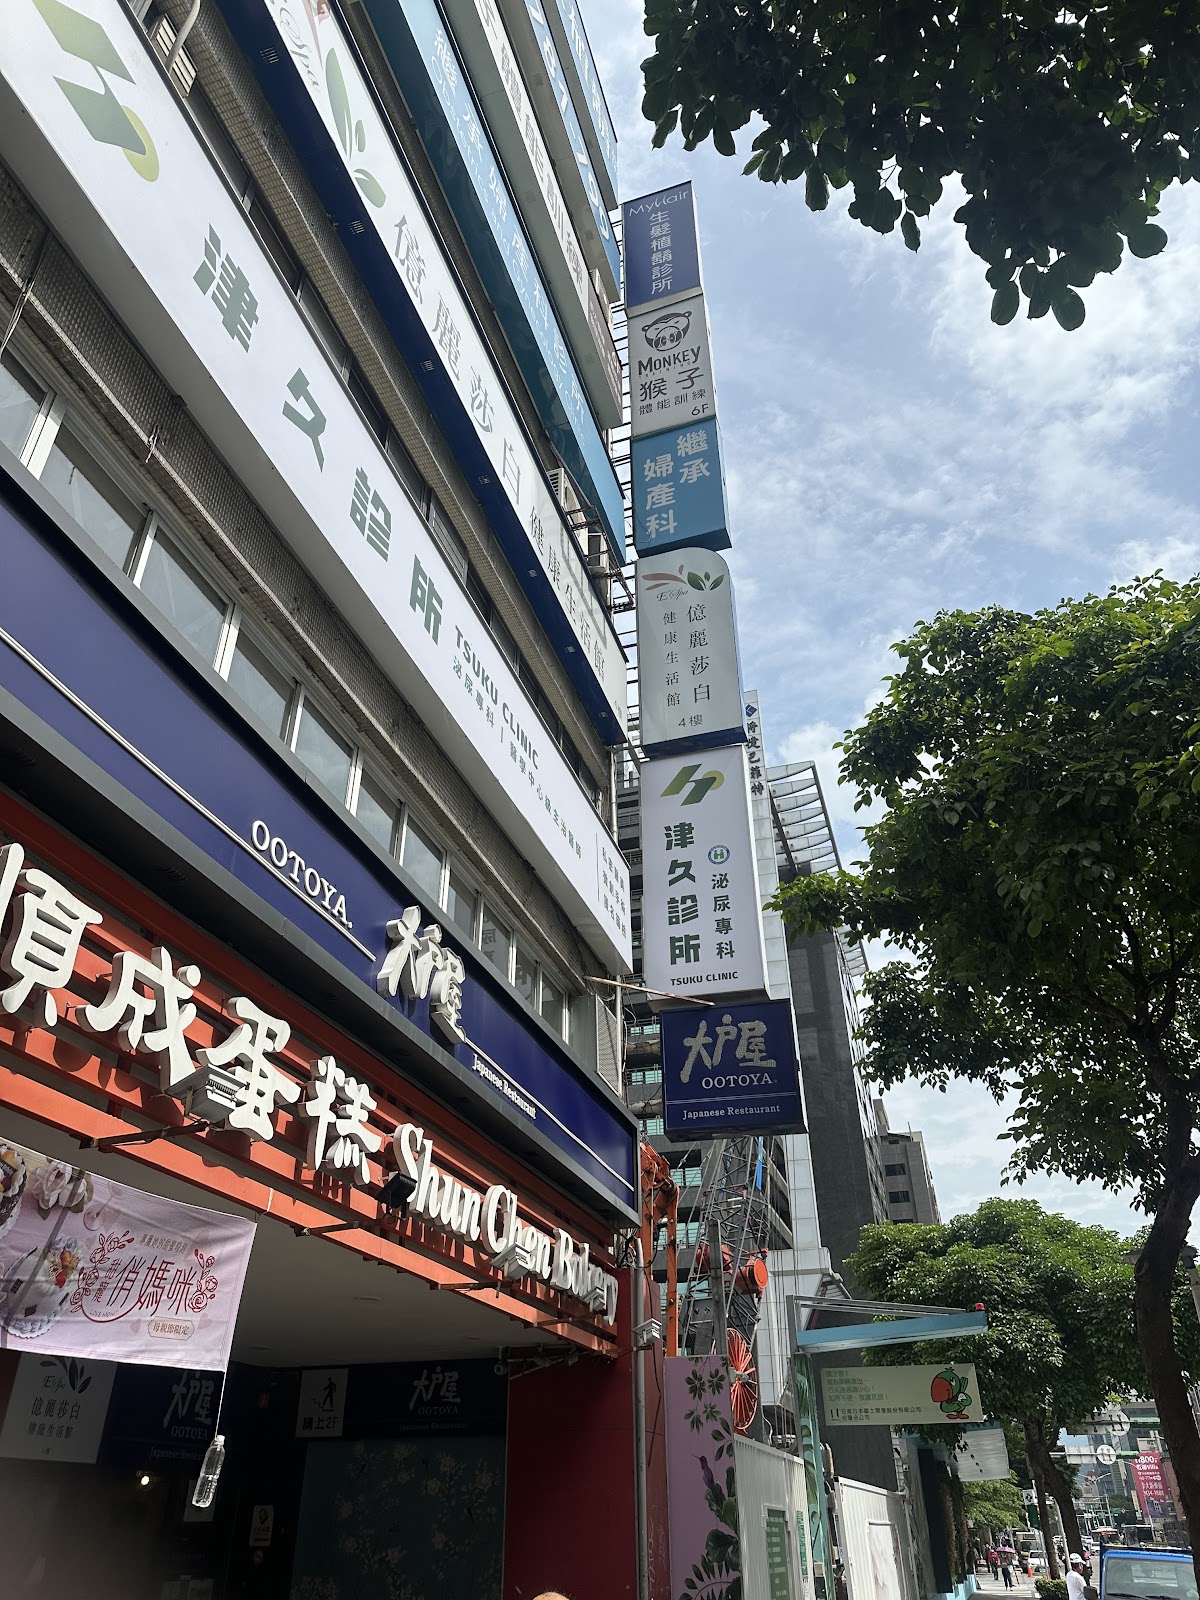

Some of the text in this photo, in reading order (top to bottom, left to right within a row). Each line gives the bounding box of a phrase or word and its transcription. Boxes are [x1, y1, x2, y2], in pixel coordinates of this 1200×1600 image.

[430, 56, 491, 204] Obstetrics
[490, 208, 512, 256] and
[432, 27, 586, 425] 繼承婦產科診所
[393, 214, 522, 505] 億麗莎白
[639, 366, 704, 402] 猴子
[639, 388, 706, 415] 體能訓練
[192, 222, 440, 646] 津久診所
[691, 403, 709, 416] 6F
[643, 454, 677, 539] 婦產科
[676, 433, 710, 484] 繼承
[529, 505, 606, 684] 健康生活館
[453, 655, 495, 729] 泌尿專科
[662, 611, 681, 708] 健康生活館
[686, 603, 711, 704] 億麗莎白
[455, 625, 540, 771] TSUKU CLINIC
[678, 713, 704, 728] 4樓
[251, 819, 350, 927] OOTOYA
[664, 821, 701, 966] 津久診所
[711, 873, 736, 960] 泌尿專科
[670, 971, 739, 986] TSUKU CLINIC
[472, 1053, 537, 1120] Japanese Restaurant
[682, 1104, 781, 1120] Japanese Restaurant
[701, 1073, 773, 1090] OOTOYA
[394, 1122, 481, 1242] Shun
[480, 1184, 551, 1280] Chen
